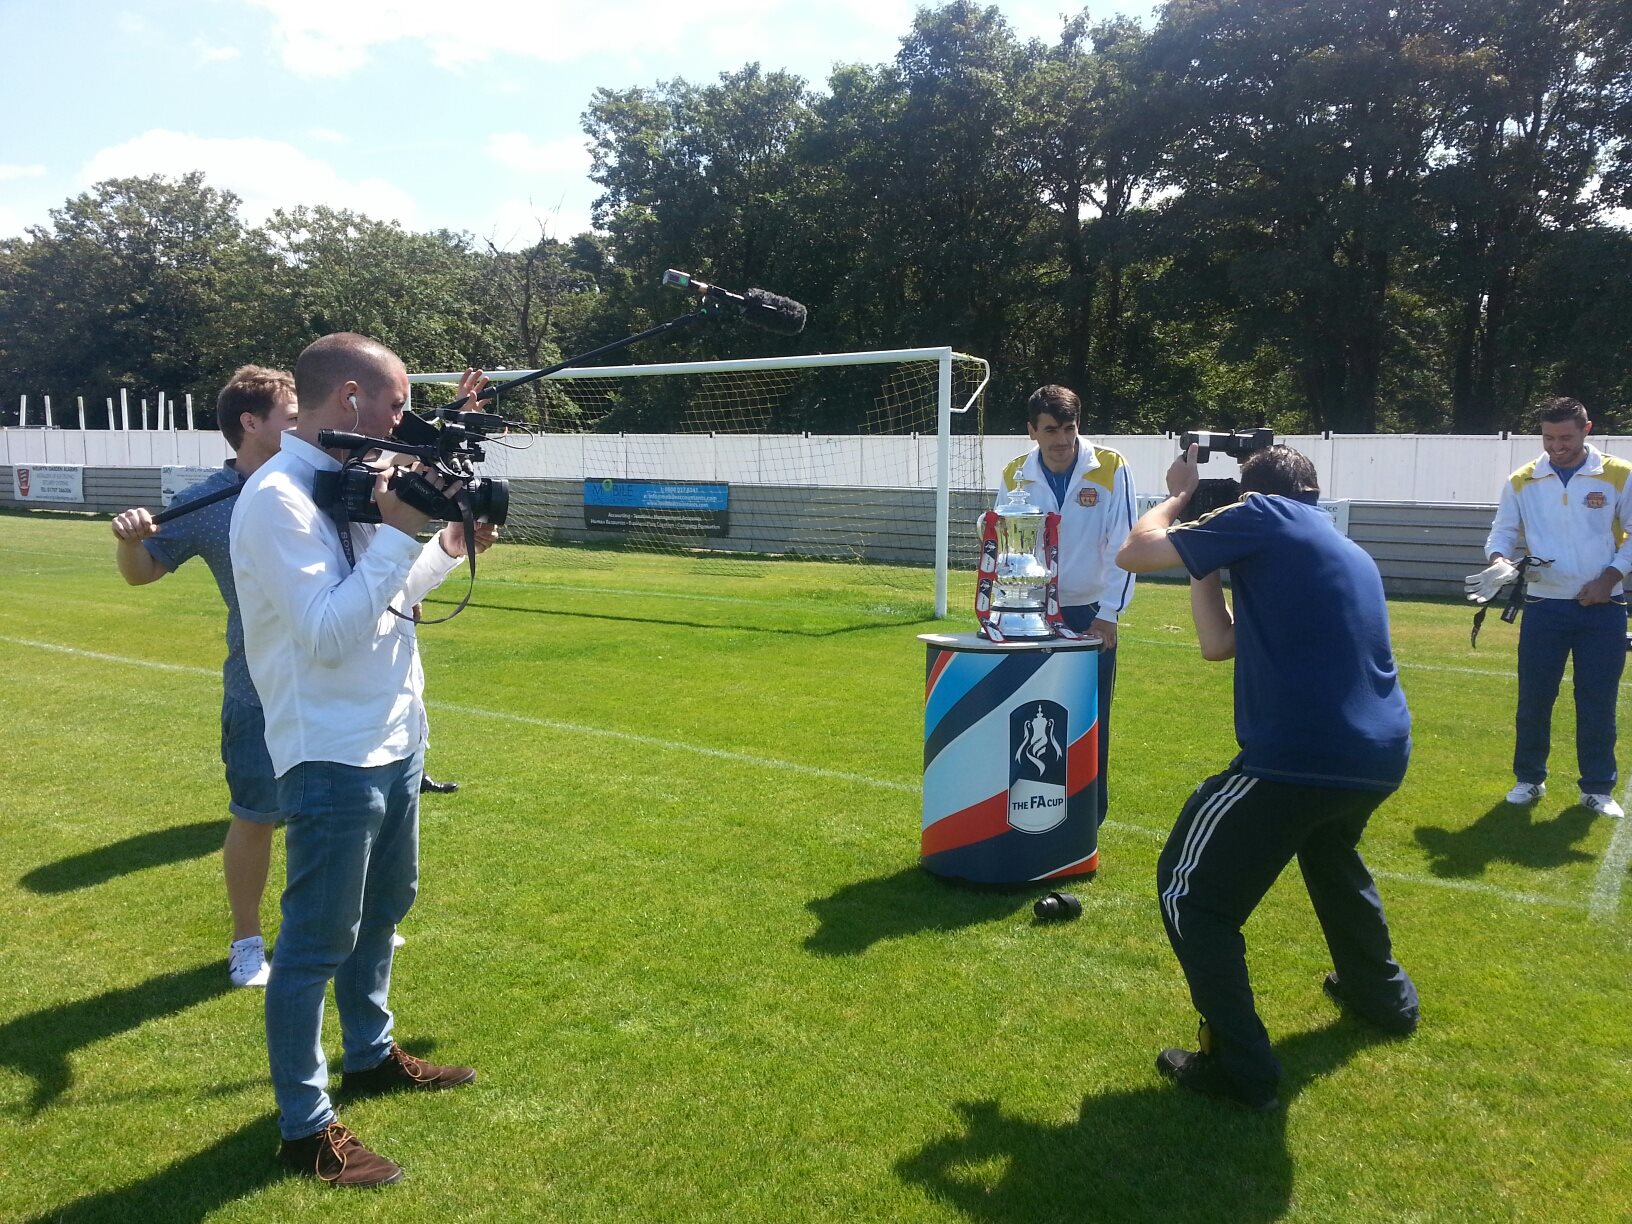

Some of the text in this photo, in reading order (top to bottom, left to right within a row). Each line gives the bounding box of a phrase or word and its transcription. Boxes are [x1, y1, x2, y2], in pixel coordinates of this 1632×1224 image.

[1012, 795, 1064, 810] THE FA CUP
